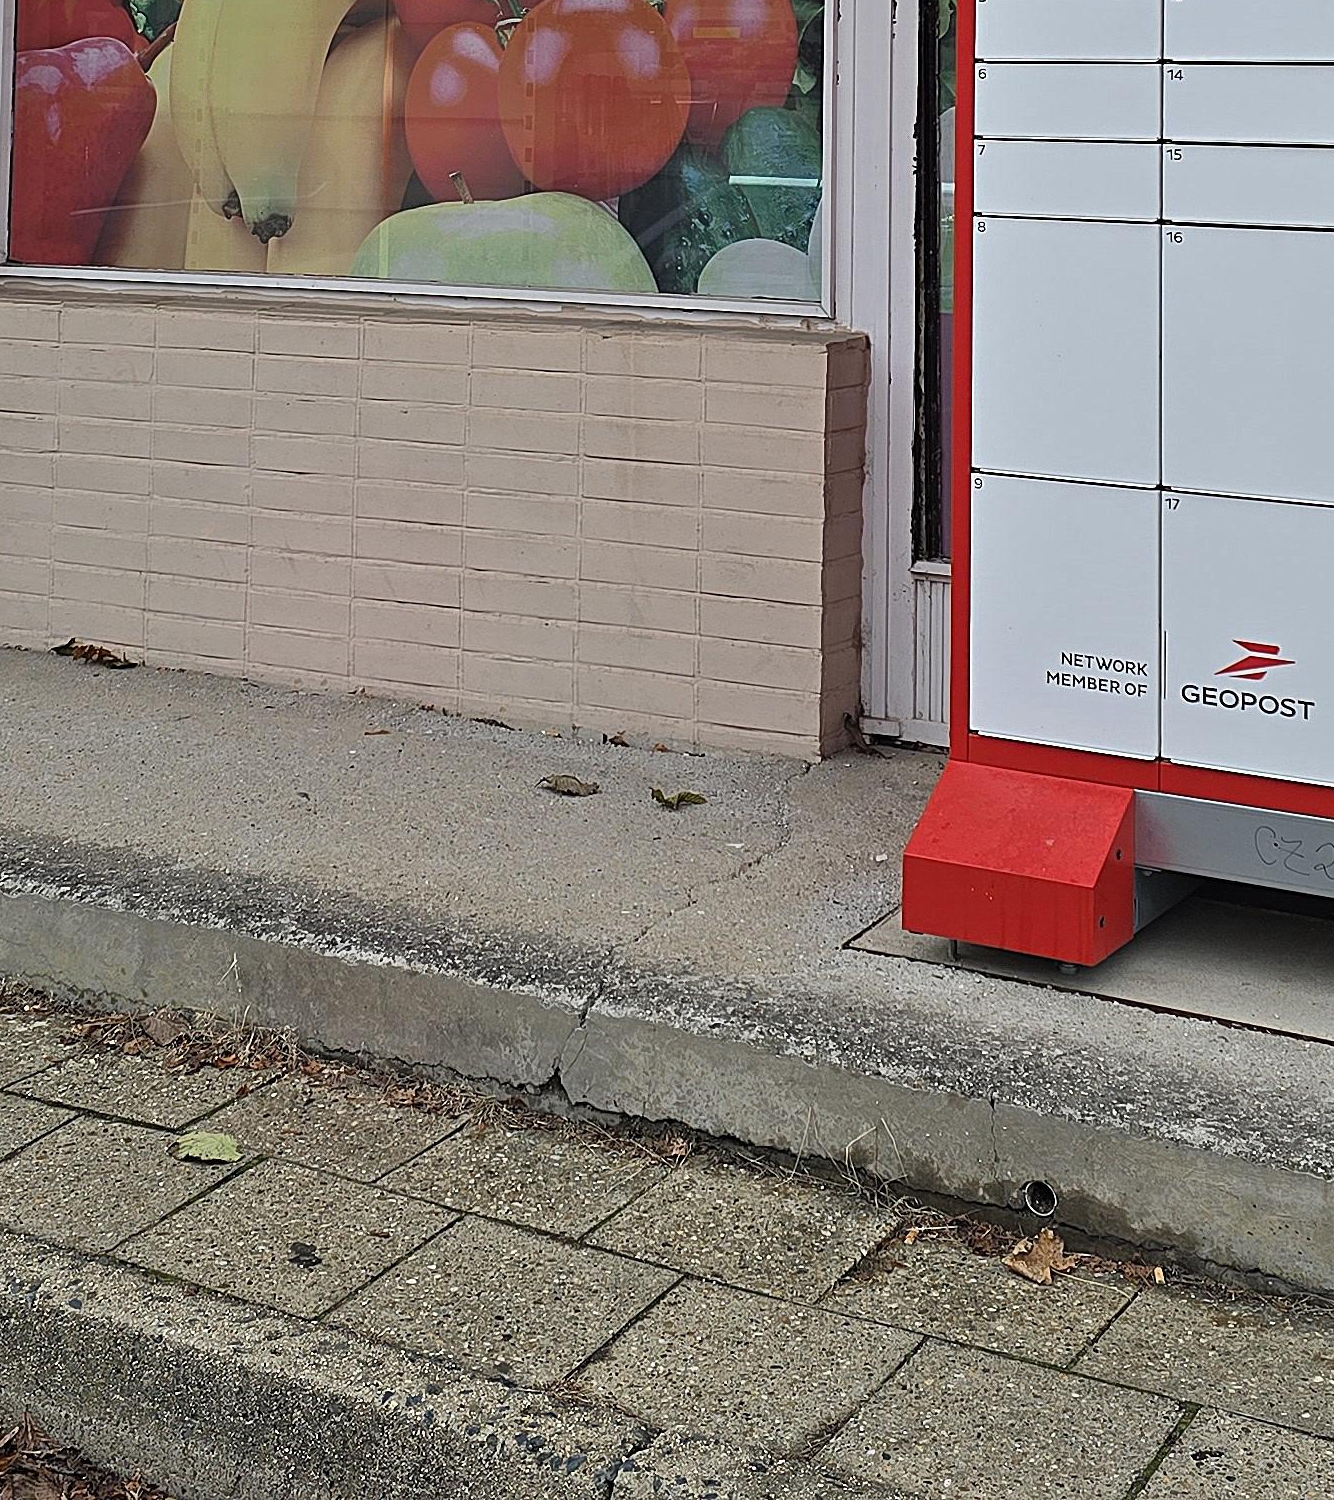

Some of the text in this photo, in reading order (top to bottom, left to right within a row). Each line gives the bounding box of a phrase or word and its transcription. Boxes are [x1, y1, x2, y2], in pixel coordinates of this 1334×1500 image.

[978, 68, 987, 80] 6
[1167, 69, 1184, 81] 14
[978, 145, 986, 156] 7
[1167, 149, 1183, 161] 15
[978, 221, 986, 233] 8
[1167, 231, 1183, 243] 16
[974, 478, 983, 490] 9
[1165, 499, 1180, 510] 17
[1061, 652, 1148, 677] NETWORK
[1046, 671, 1148, 697] MEMBER OF
[1181, 684, 1315, 720] GEOPOST
